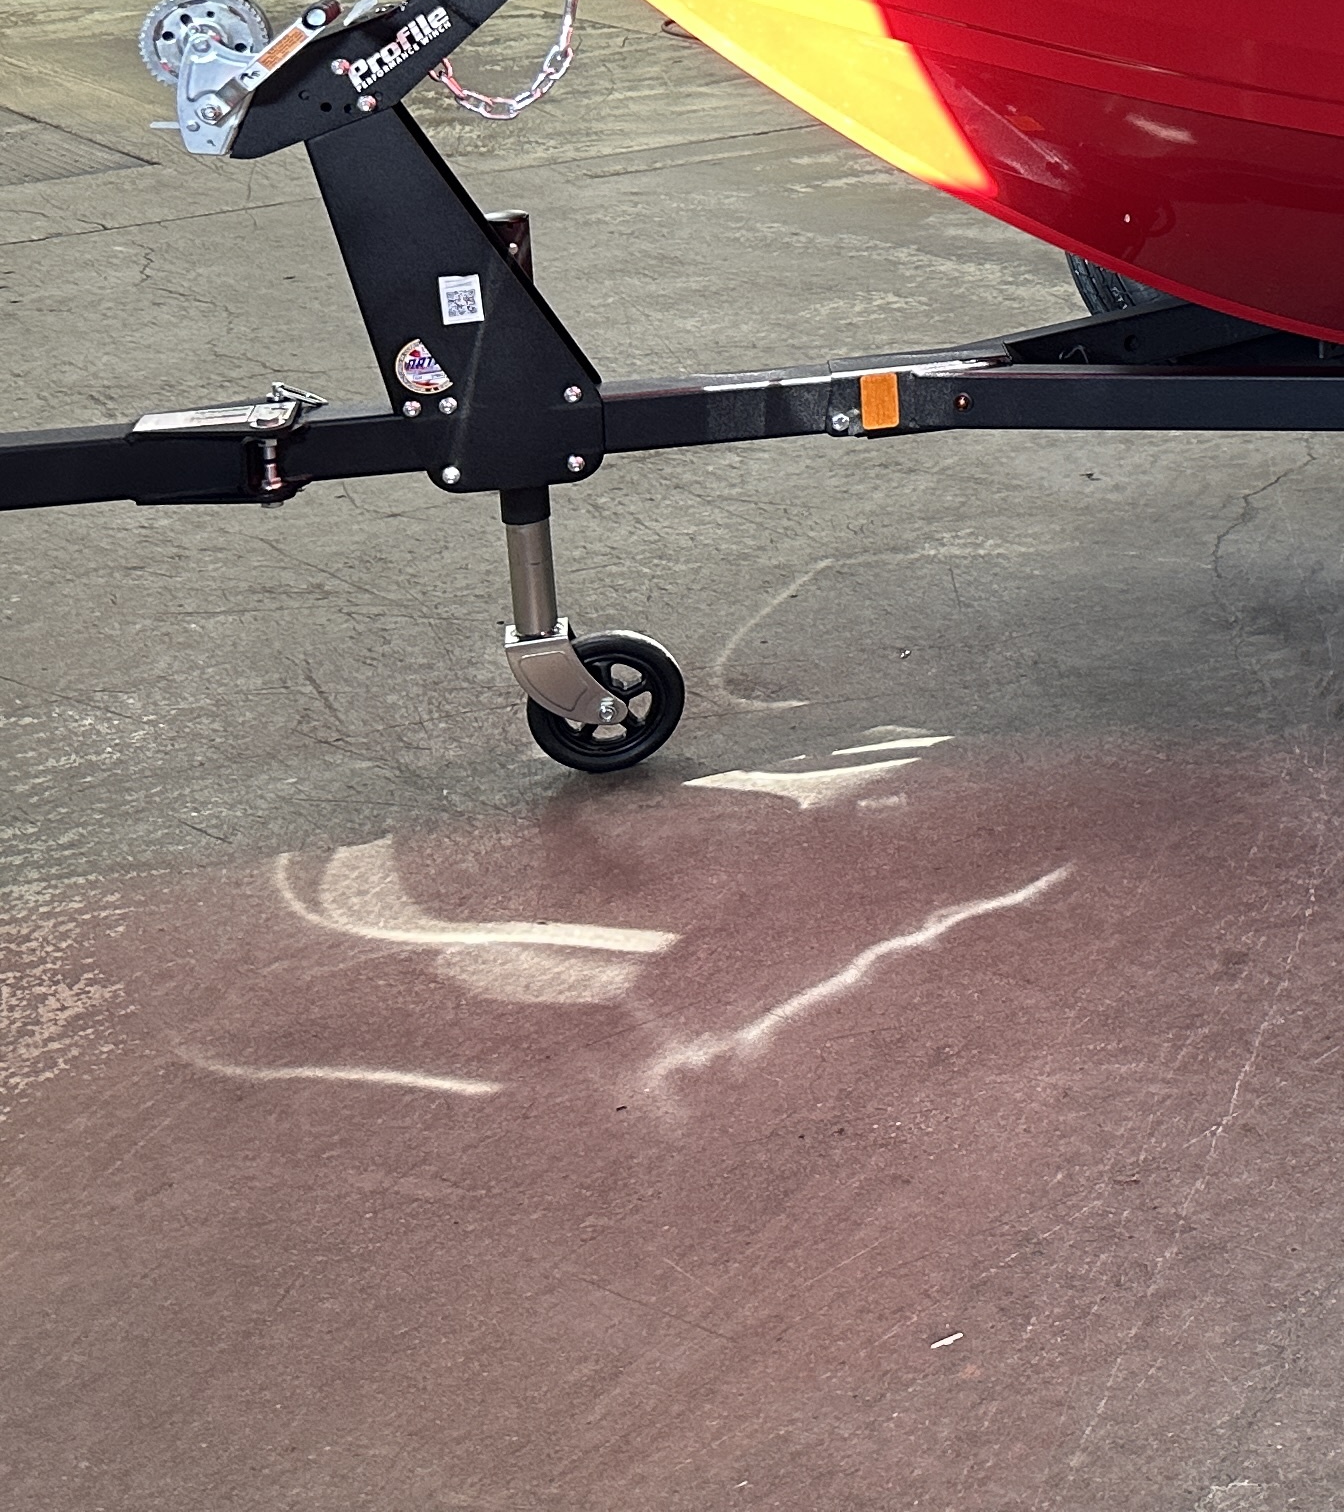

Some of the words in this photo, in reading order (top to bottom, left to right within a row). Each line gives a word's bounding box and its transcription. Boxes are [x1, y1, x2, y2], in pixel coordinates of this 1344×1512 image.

[348, 6, 450, 90] Profile
[355, 46, 420, 93] PERFORMANCE
[419, 20, 452, 46] WINCH
